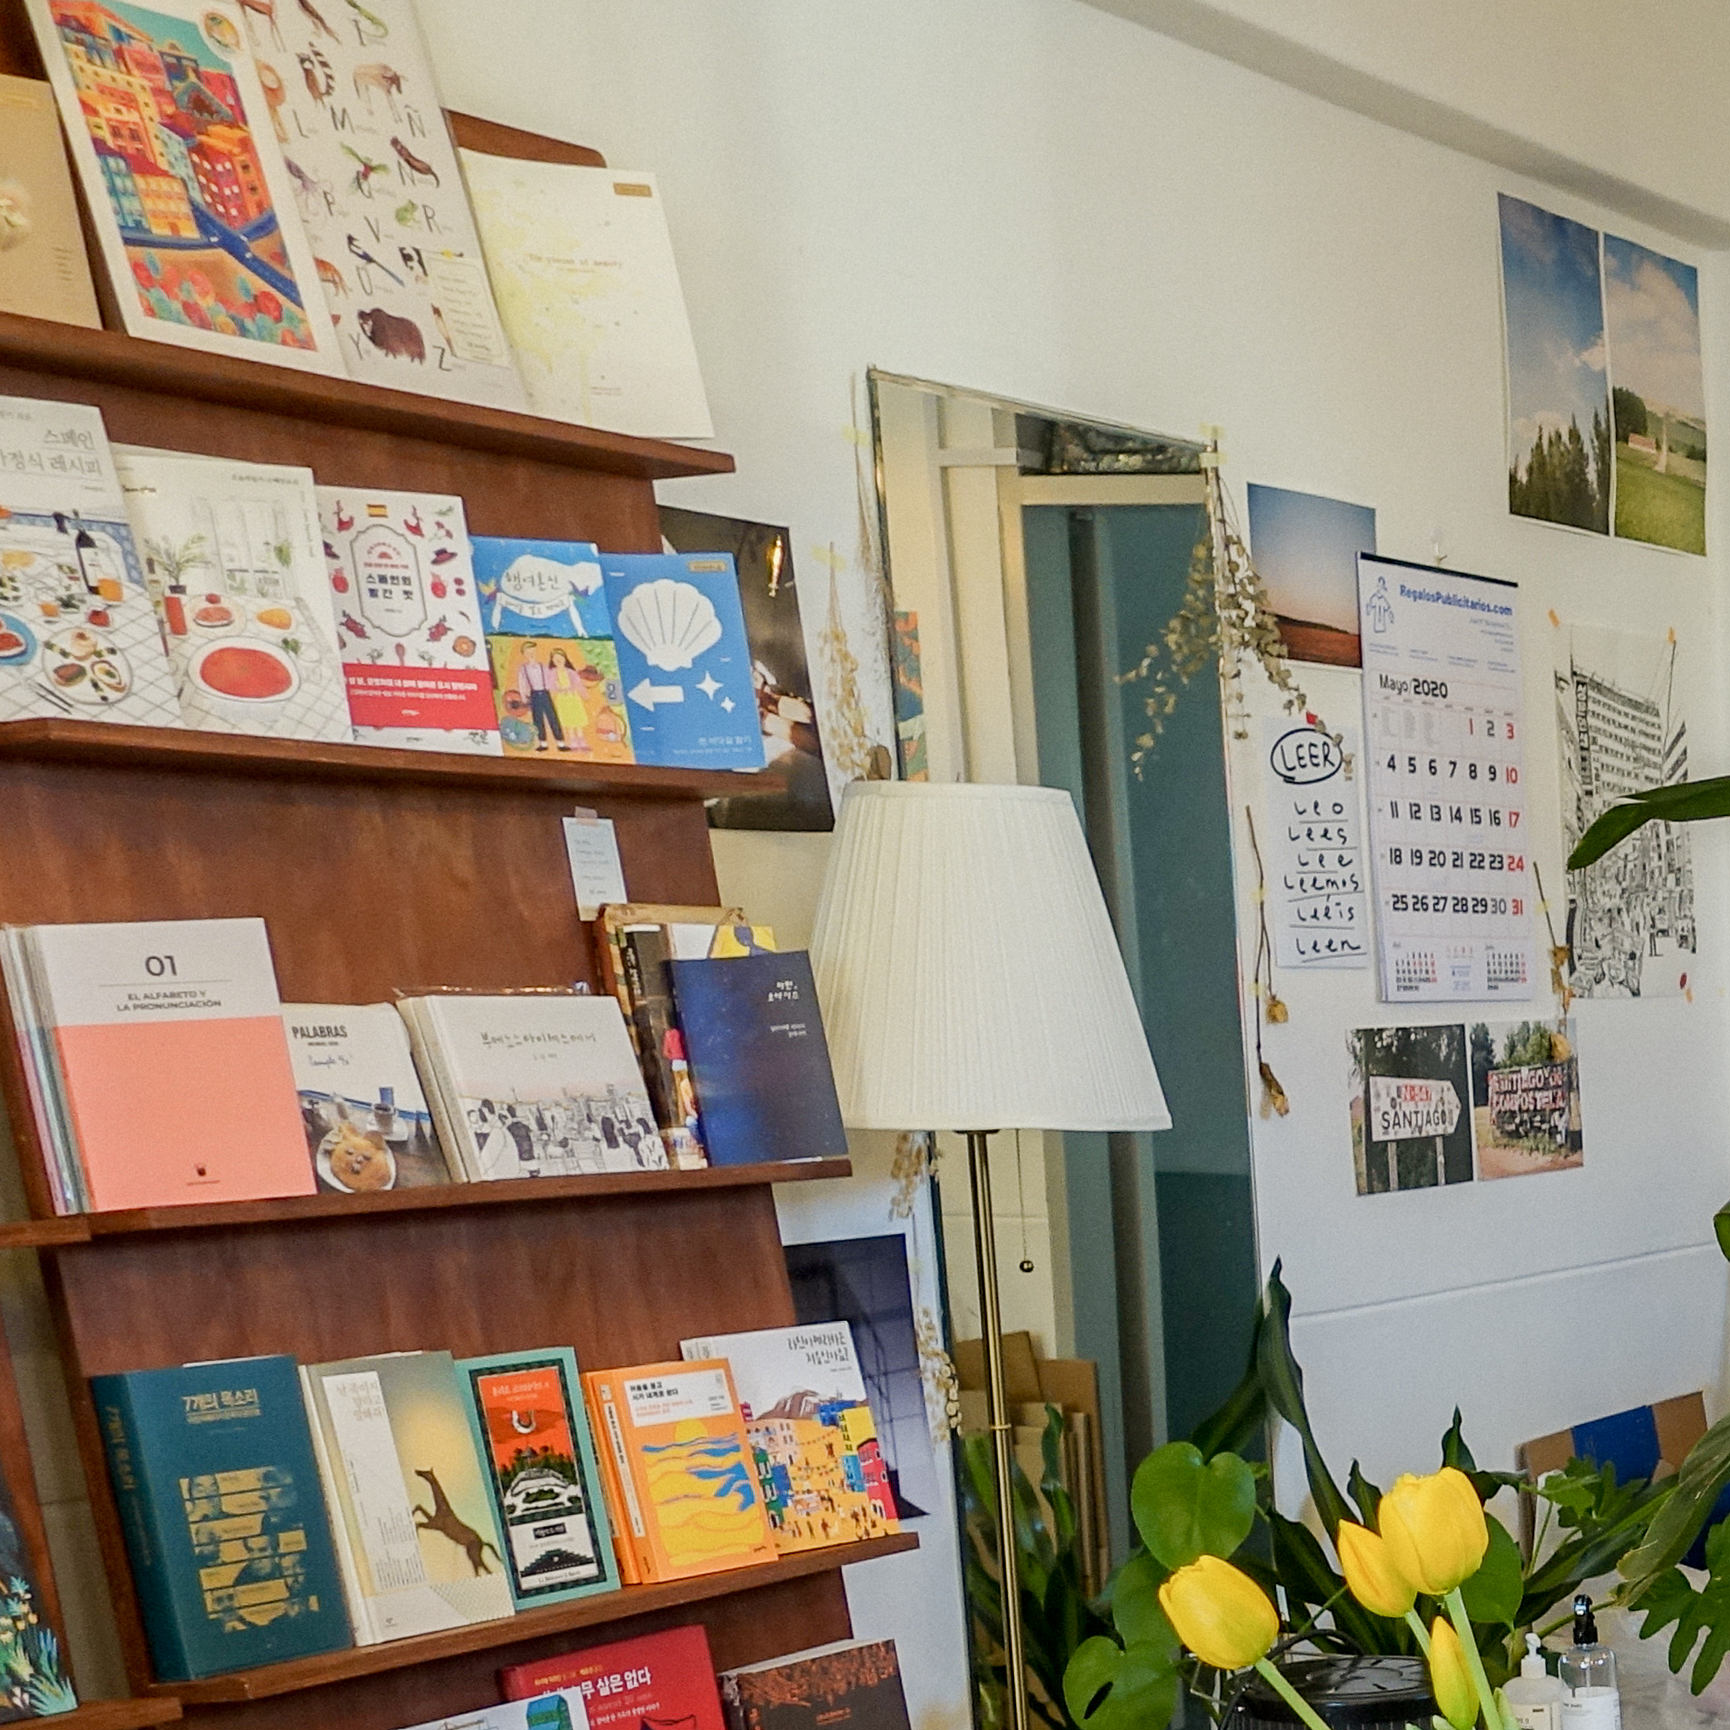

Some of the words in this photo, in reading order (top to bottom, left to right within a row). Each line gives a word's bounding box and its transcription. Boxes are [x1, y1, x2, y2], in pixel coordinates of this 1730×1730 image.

[43, 428, 96, 450] 스페인
[48, 453, 102, 477] 레시피
[1399, 583, 1513, 617] RegalosPublicitarios.com
[1379, 674, 1409, 695] Mayo
[1413, 678, 1448, 699] 2020
[1280, 740, 1336, 772] LEER
[1387, 754, 1397, 772] 4
[1408, 756, 1417, 774] 5
[1428, 758, 1437, 776] 6
[1449, 761, 1458, 779] 7
[1468, 763, 1478, 781] 8
[1488, 765, 1497, 782] 9
[1505, 767, 1518, 784] 10
[1390, 801, 1399, 819] 11
[1409, 802, 1422, 821] 12
[1430, 804, 1442, 822] 13
[1449, 805, 1463, 824] 14
[1469, 808, 1482, 825] 15
[1489, 809, 1501, 827] 16
[1508, 811, 1521, 828] 17
[1389, 847, 1403, 866] 18
[1410, 848, 1423, 866] 19
[1428, 849, 1446, 868] 20
[1451, 851, 1464, 869] 21
[1469, 852, 1486, 870] 22
[1488, 853, 1504, 871] 23
[1507, 855, 1524, 872] 24
[1392, 894, 1409, 912] 25
[1411, 894, 1429, 912] 26
[1432, 896, 1448, 913] 27
[1452, 896, 1469, 914] 28
[1471, 897, 1488, 915] 29
[1490, 898, 1507, 915] 30
[1512, 899, 1523, 916] 31
[145, 954, 177, 977] 01
[132, 998, 222, 1011] PRONUNCIACIÓN
[143, 990, 198, 1001] ALFABETO
[291, 1025, 348, 1039] PALABRAS
[1381, 1108, 1447, 1131] SANTIAGO
[624, 1665, 652, 1691] 없다
